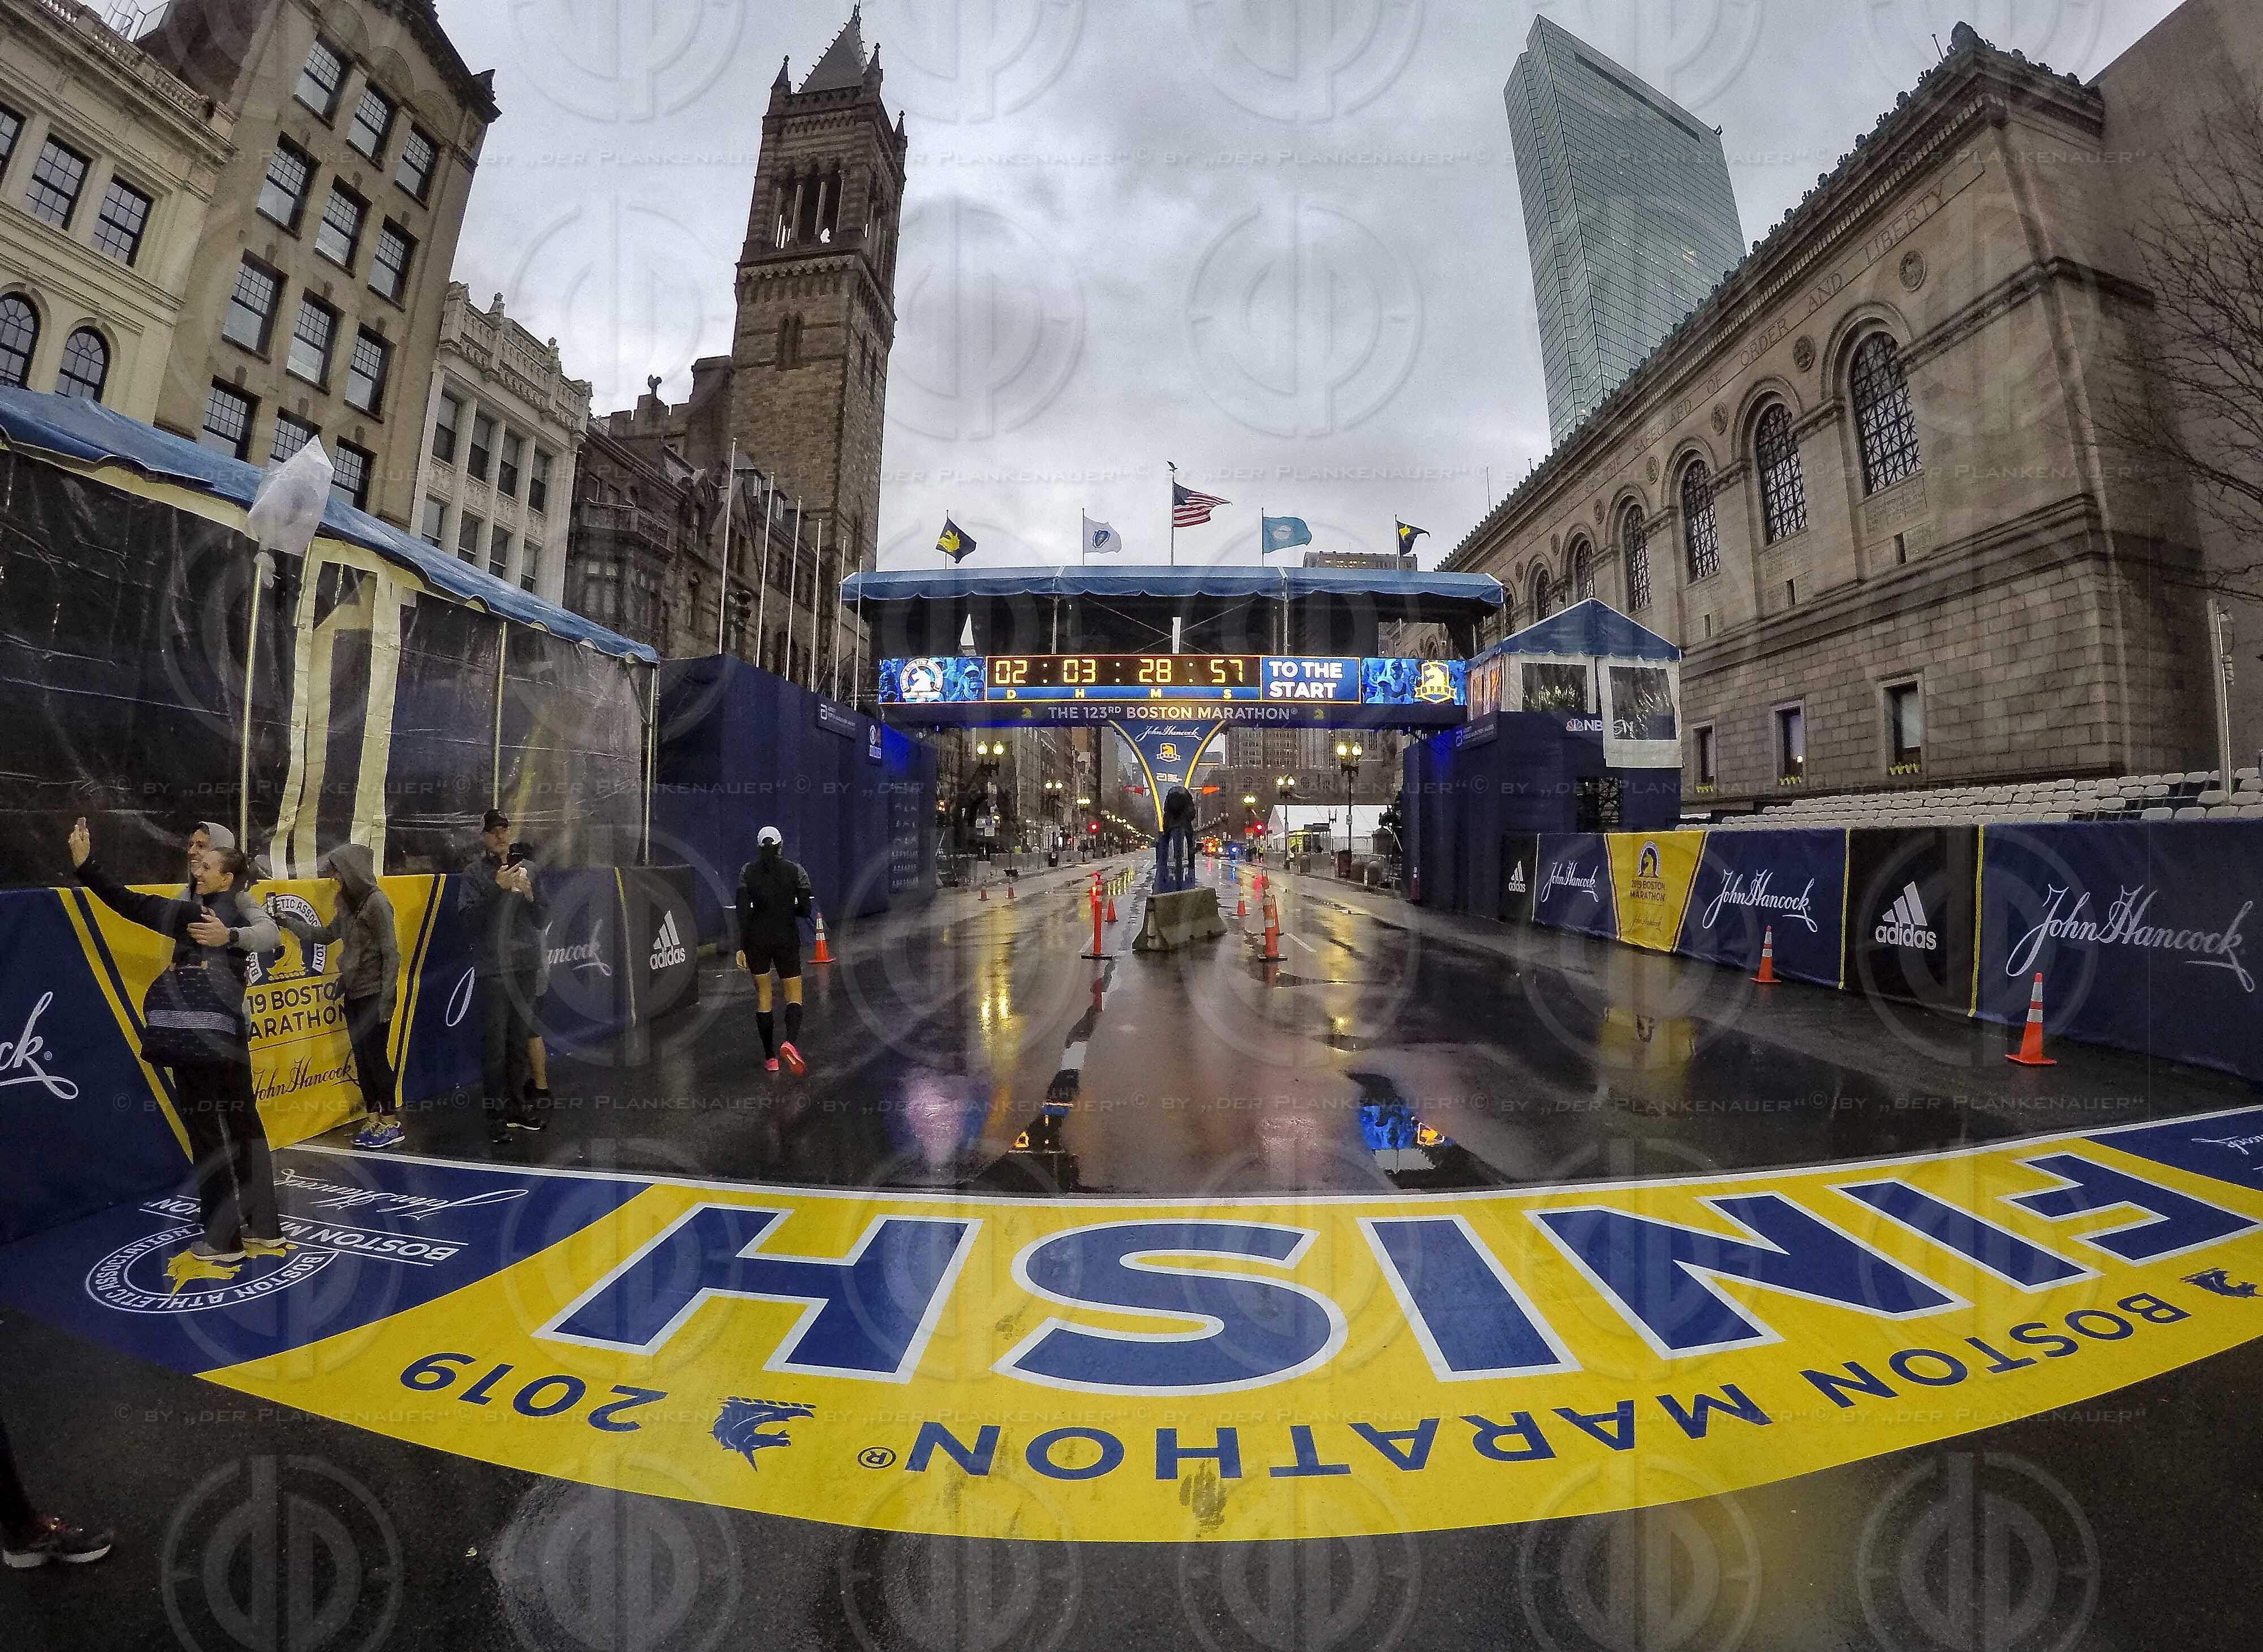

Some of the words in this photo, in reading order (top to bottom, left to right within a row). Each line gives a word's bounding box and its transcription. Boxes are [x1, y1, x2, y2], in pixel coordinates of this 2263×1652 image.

[1739, 318, 1789, 368] ORDER
[1809, 272, 1844, 313] AND
[1864, 182, 1947, 266] LIBERTY
[995, 659, 1029, 684] 02
[1062, 659, 1097, 683] 03
[1138, 659, 1173, 683] 28
[1210, 659, 1244, 683] 57
[1268, 661, 1300, 678] TO
[1301, 661, 1344, 679] THE
[1005, 689, 1017, 699] D
[1074, 688, 1086, 699] H
[1149, 687, 1163, 698] M
[1222, 688, 1233, 699] S
[1268, 681, 1338, 699] START
[1048, 707, 1078, 719] THE
[1126, 706, 1192, 719] BOSTON
[1134, 725, 1162, 742] John
[1161, 724, 1203, 741] Hancock
[1508, 881, 1526, 893] adidas
[1541, 861, 1565, 903] John
[1564, 860, 1599, 902] Hancock
[1642, 879, 1666, 891] BOSTON
[1630, 890, 1666, 902] MARATHON
[1702, 868, 1745, 929] John
[1744, 868, 1818, 933] Hancock
[1875, 923, 1937, 950] adidas
[2006, 883, 2099, 977] John
[2098, 884, 2255, 992] Hancock
[649, 945, 686, 970] adidas
[247, 993, 267, 1015] 19
[286, 1048, 363, 1094] Hancock
[376, 1189, 529, 1221] John
[311, 1228, 460, 1261] BOSTON
[95, 1228, 192, 1291] ASSOCIATION
[531, 1150, 2263, 1396] FINISH
[234, 1255, 325, 1298] BOSTON
[105, 1289, 225, 1309] ATHLETIC
[1800, 1292, 2192, 1408] BOSTON
[399, 1351, 668, 1432] 2019
